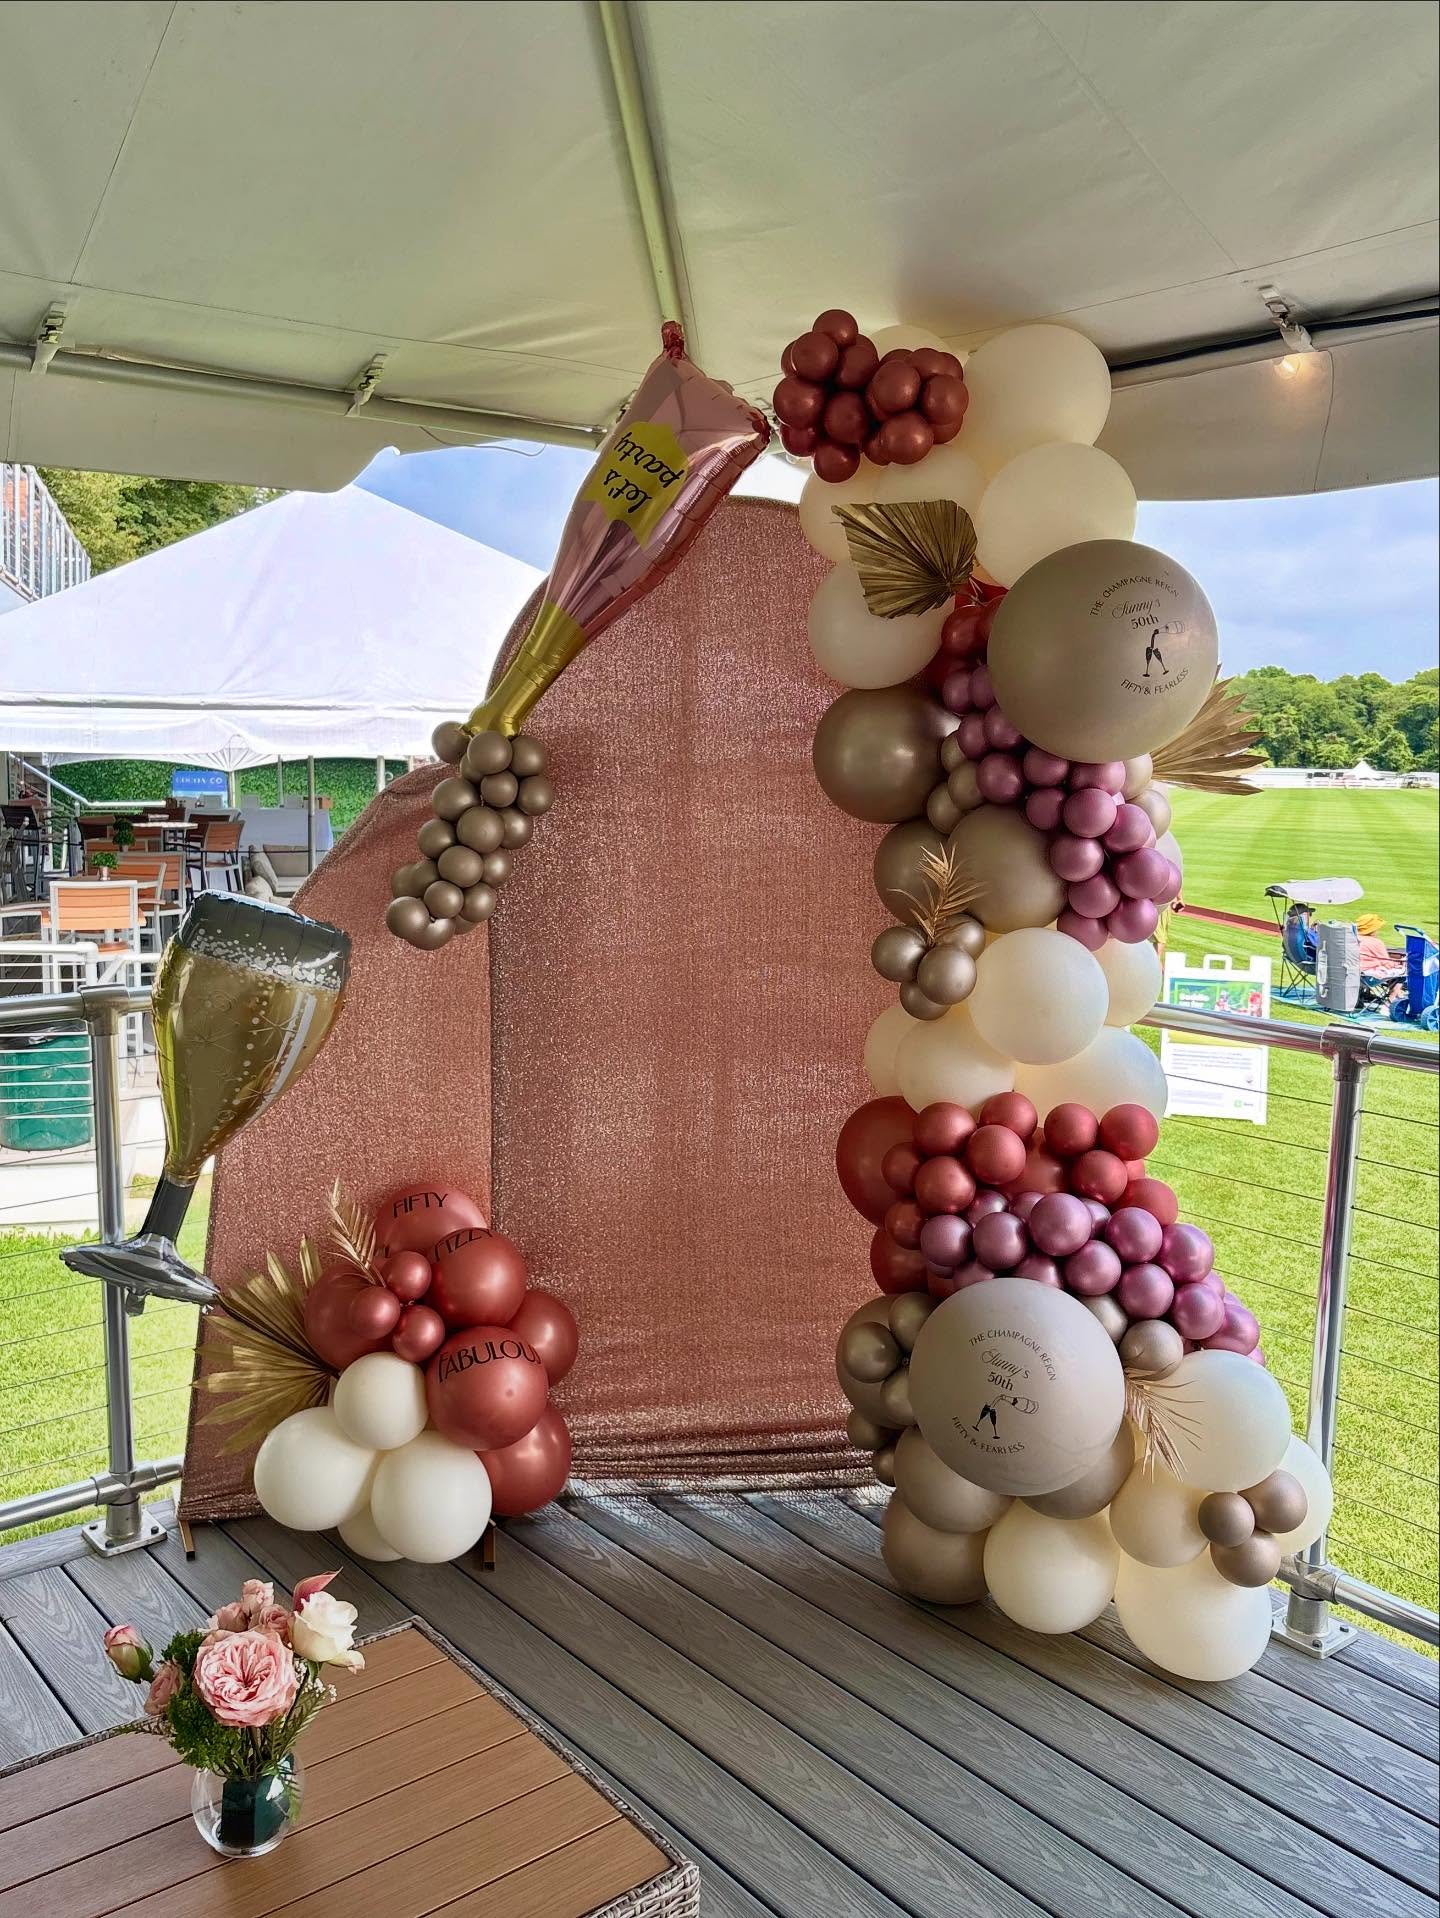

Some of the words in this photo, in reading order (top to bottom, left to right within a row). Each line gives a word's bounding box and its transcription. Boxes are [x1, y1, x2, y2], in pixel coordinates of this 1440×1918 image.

[614, 431, 685, 489] party
[1090, 600, 1104, 617] THE
[1102, 575, 1153, 598] CHAMPAGNE
[1130, 614, 1159, 630] 50th
[1121, 679, 1143, 694] FIFTY
[1144, 686, 1151, 696] &
[1154, 668, 1189, 695] FEARLESS
[393, 1191, 448, 1218] FIFTY
[968, 1332, 985, 1347] THE
[987, 1329, 1041, 1354] CHAMPAGNE
[1039, 1352, 1057, 1381] REIGN
[987, 1371, 1014, 1392] 50th
[952, 1416, 969, 1439] FIFTY
[980, 1441, 1025, 1455] FEARLESS
